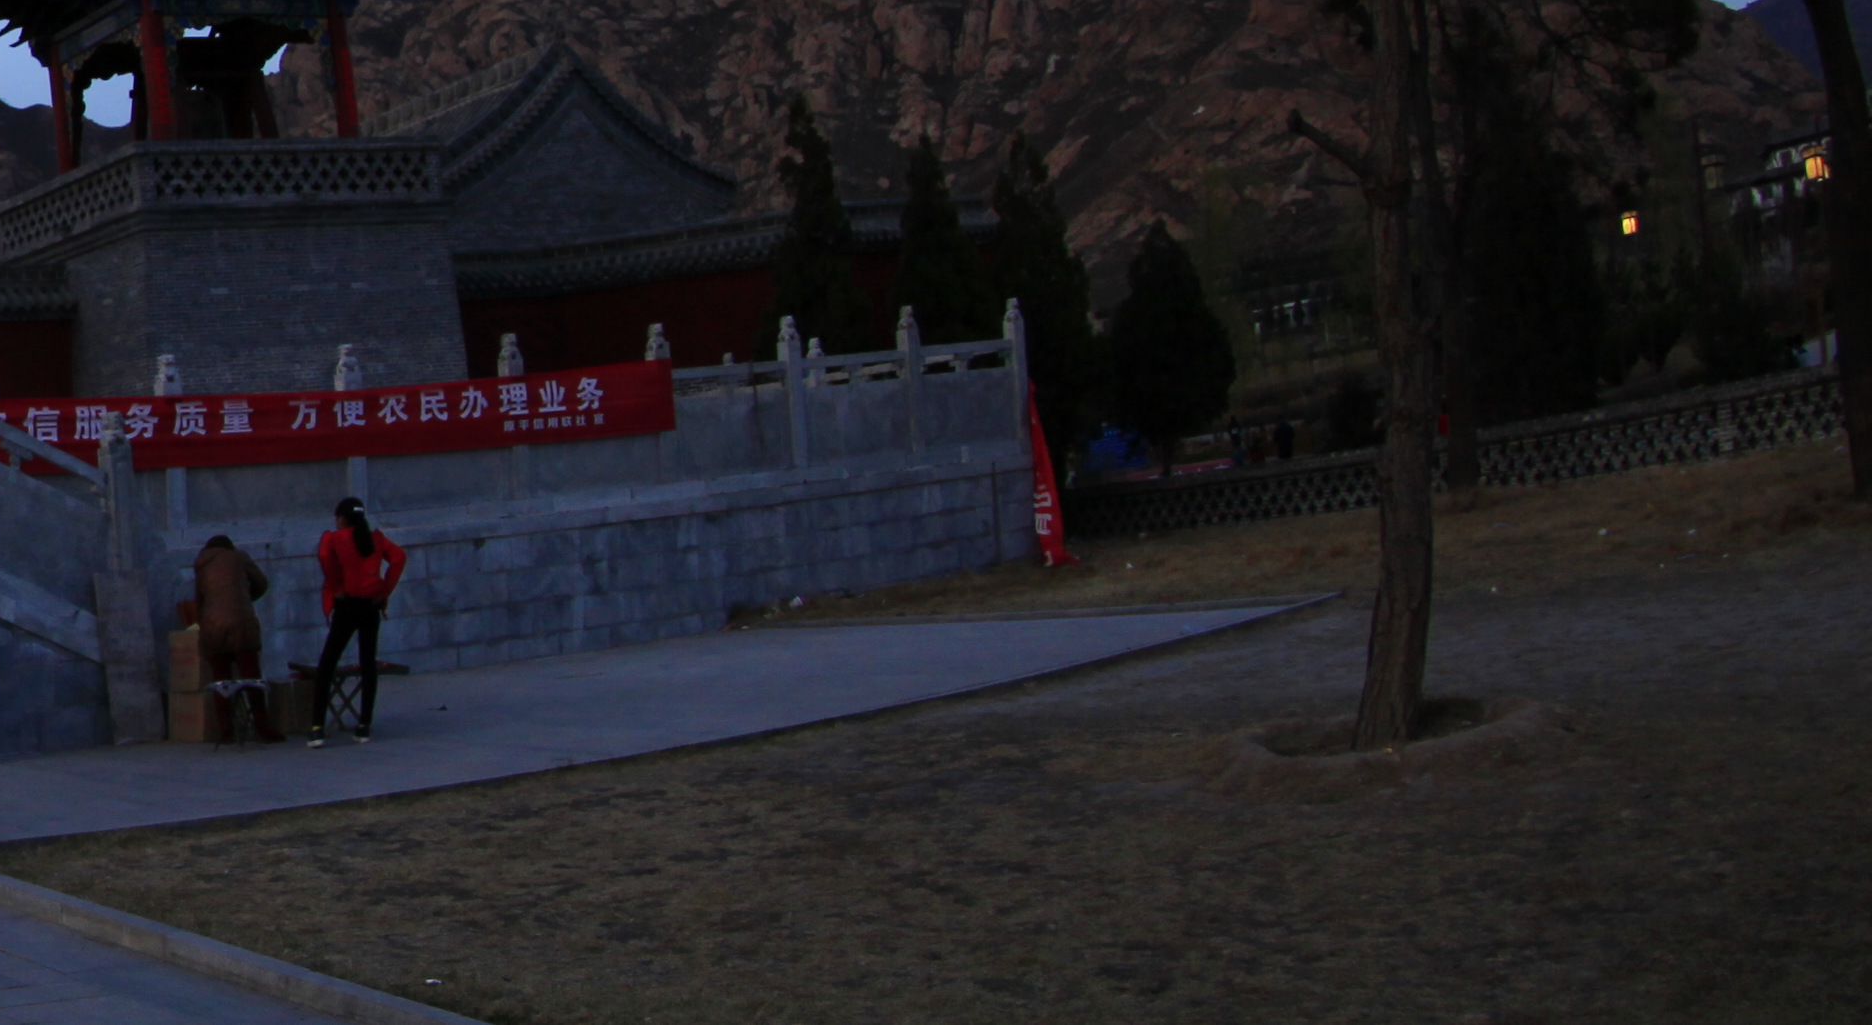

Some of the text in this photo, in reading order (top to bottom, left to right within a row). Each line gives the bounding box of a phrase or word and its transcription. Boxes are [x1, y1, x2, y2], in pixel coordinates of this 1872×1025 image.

[288, 377, 605, 430] 方便农民办理业务
